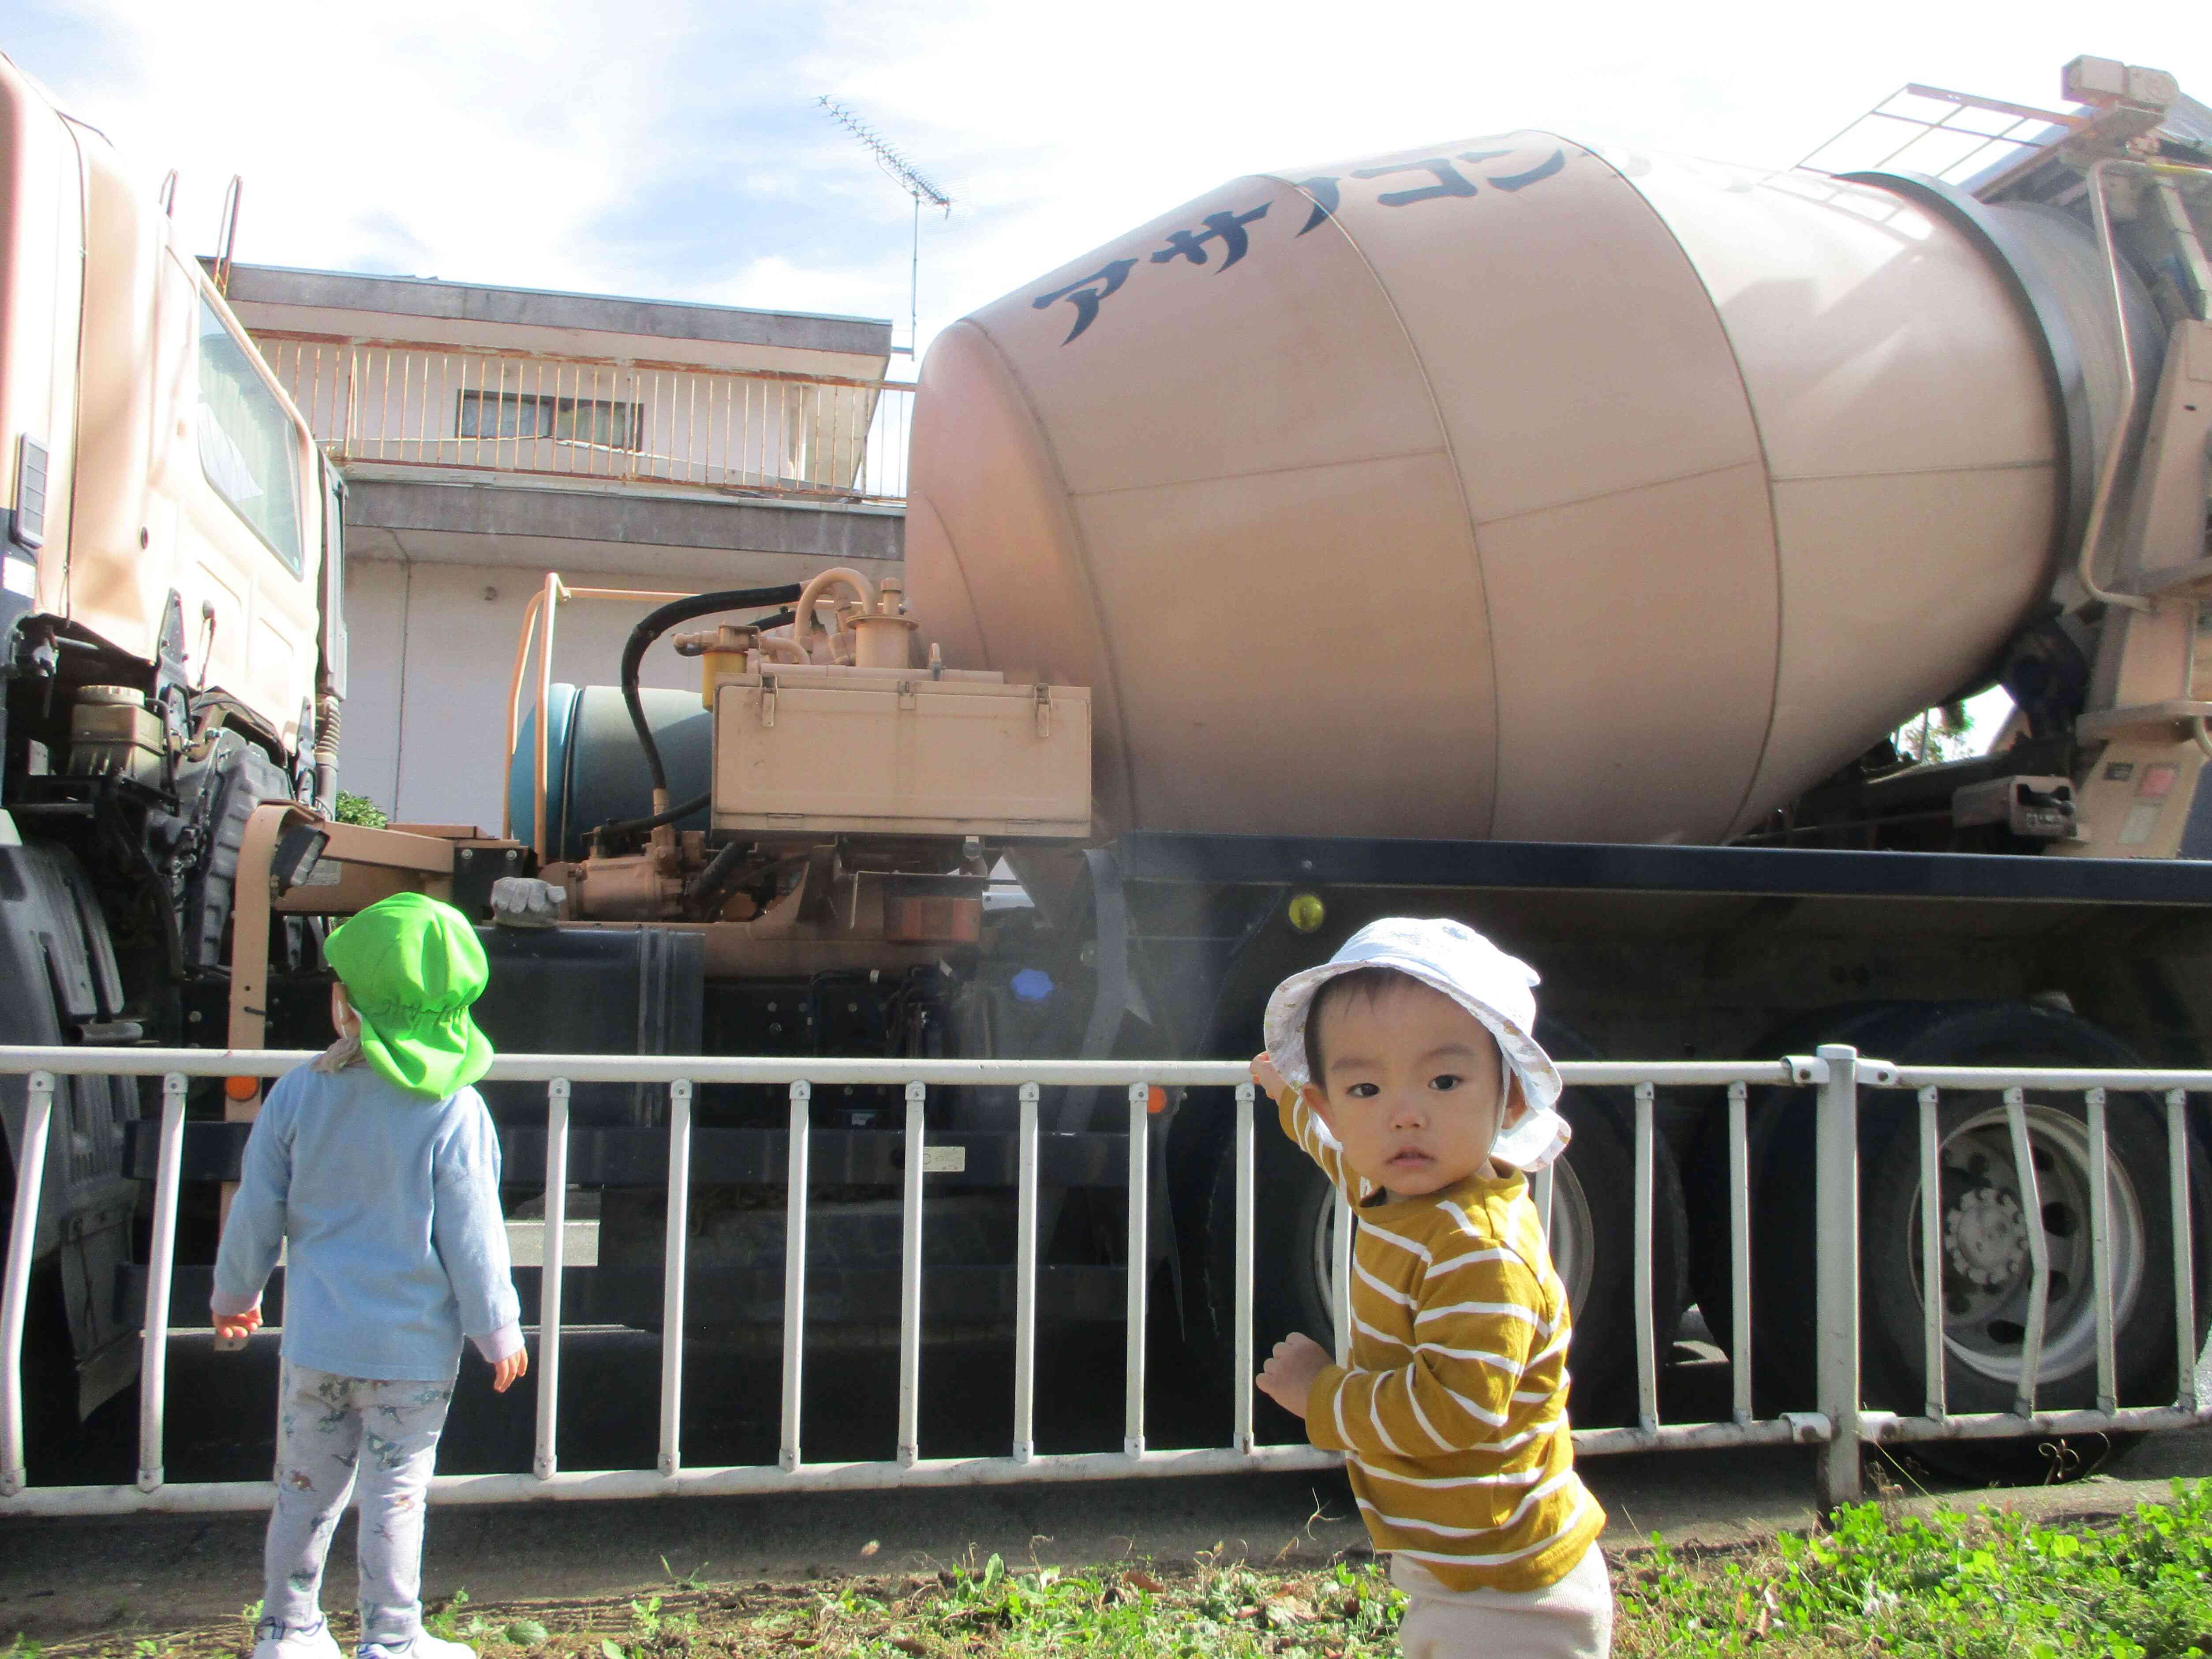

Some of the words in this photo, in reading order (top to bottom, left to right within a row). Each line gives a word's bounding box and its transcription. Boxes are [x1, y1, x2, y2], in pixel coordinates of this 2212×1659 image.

[1032, 142, 1652, 348] アサノコン
